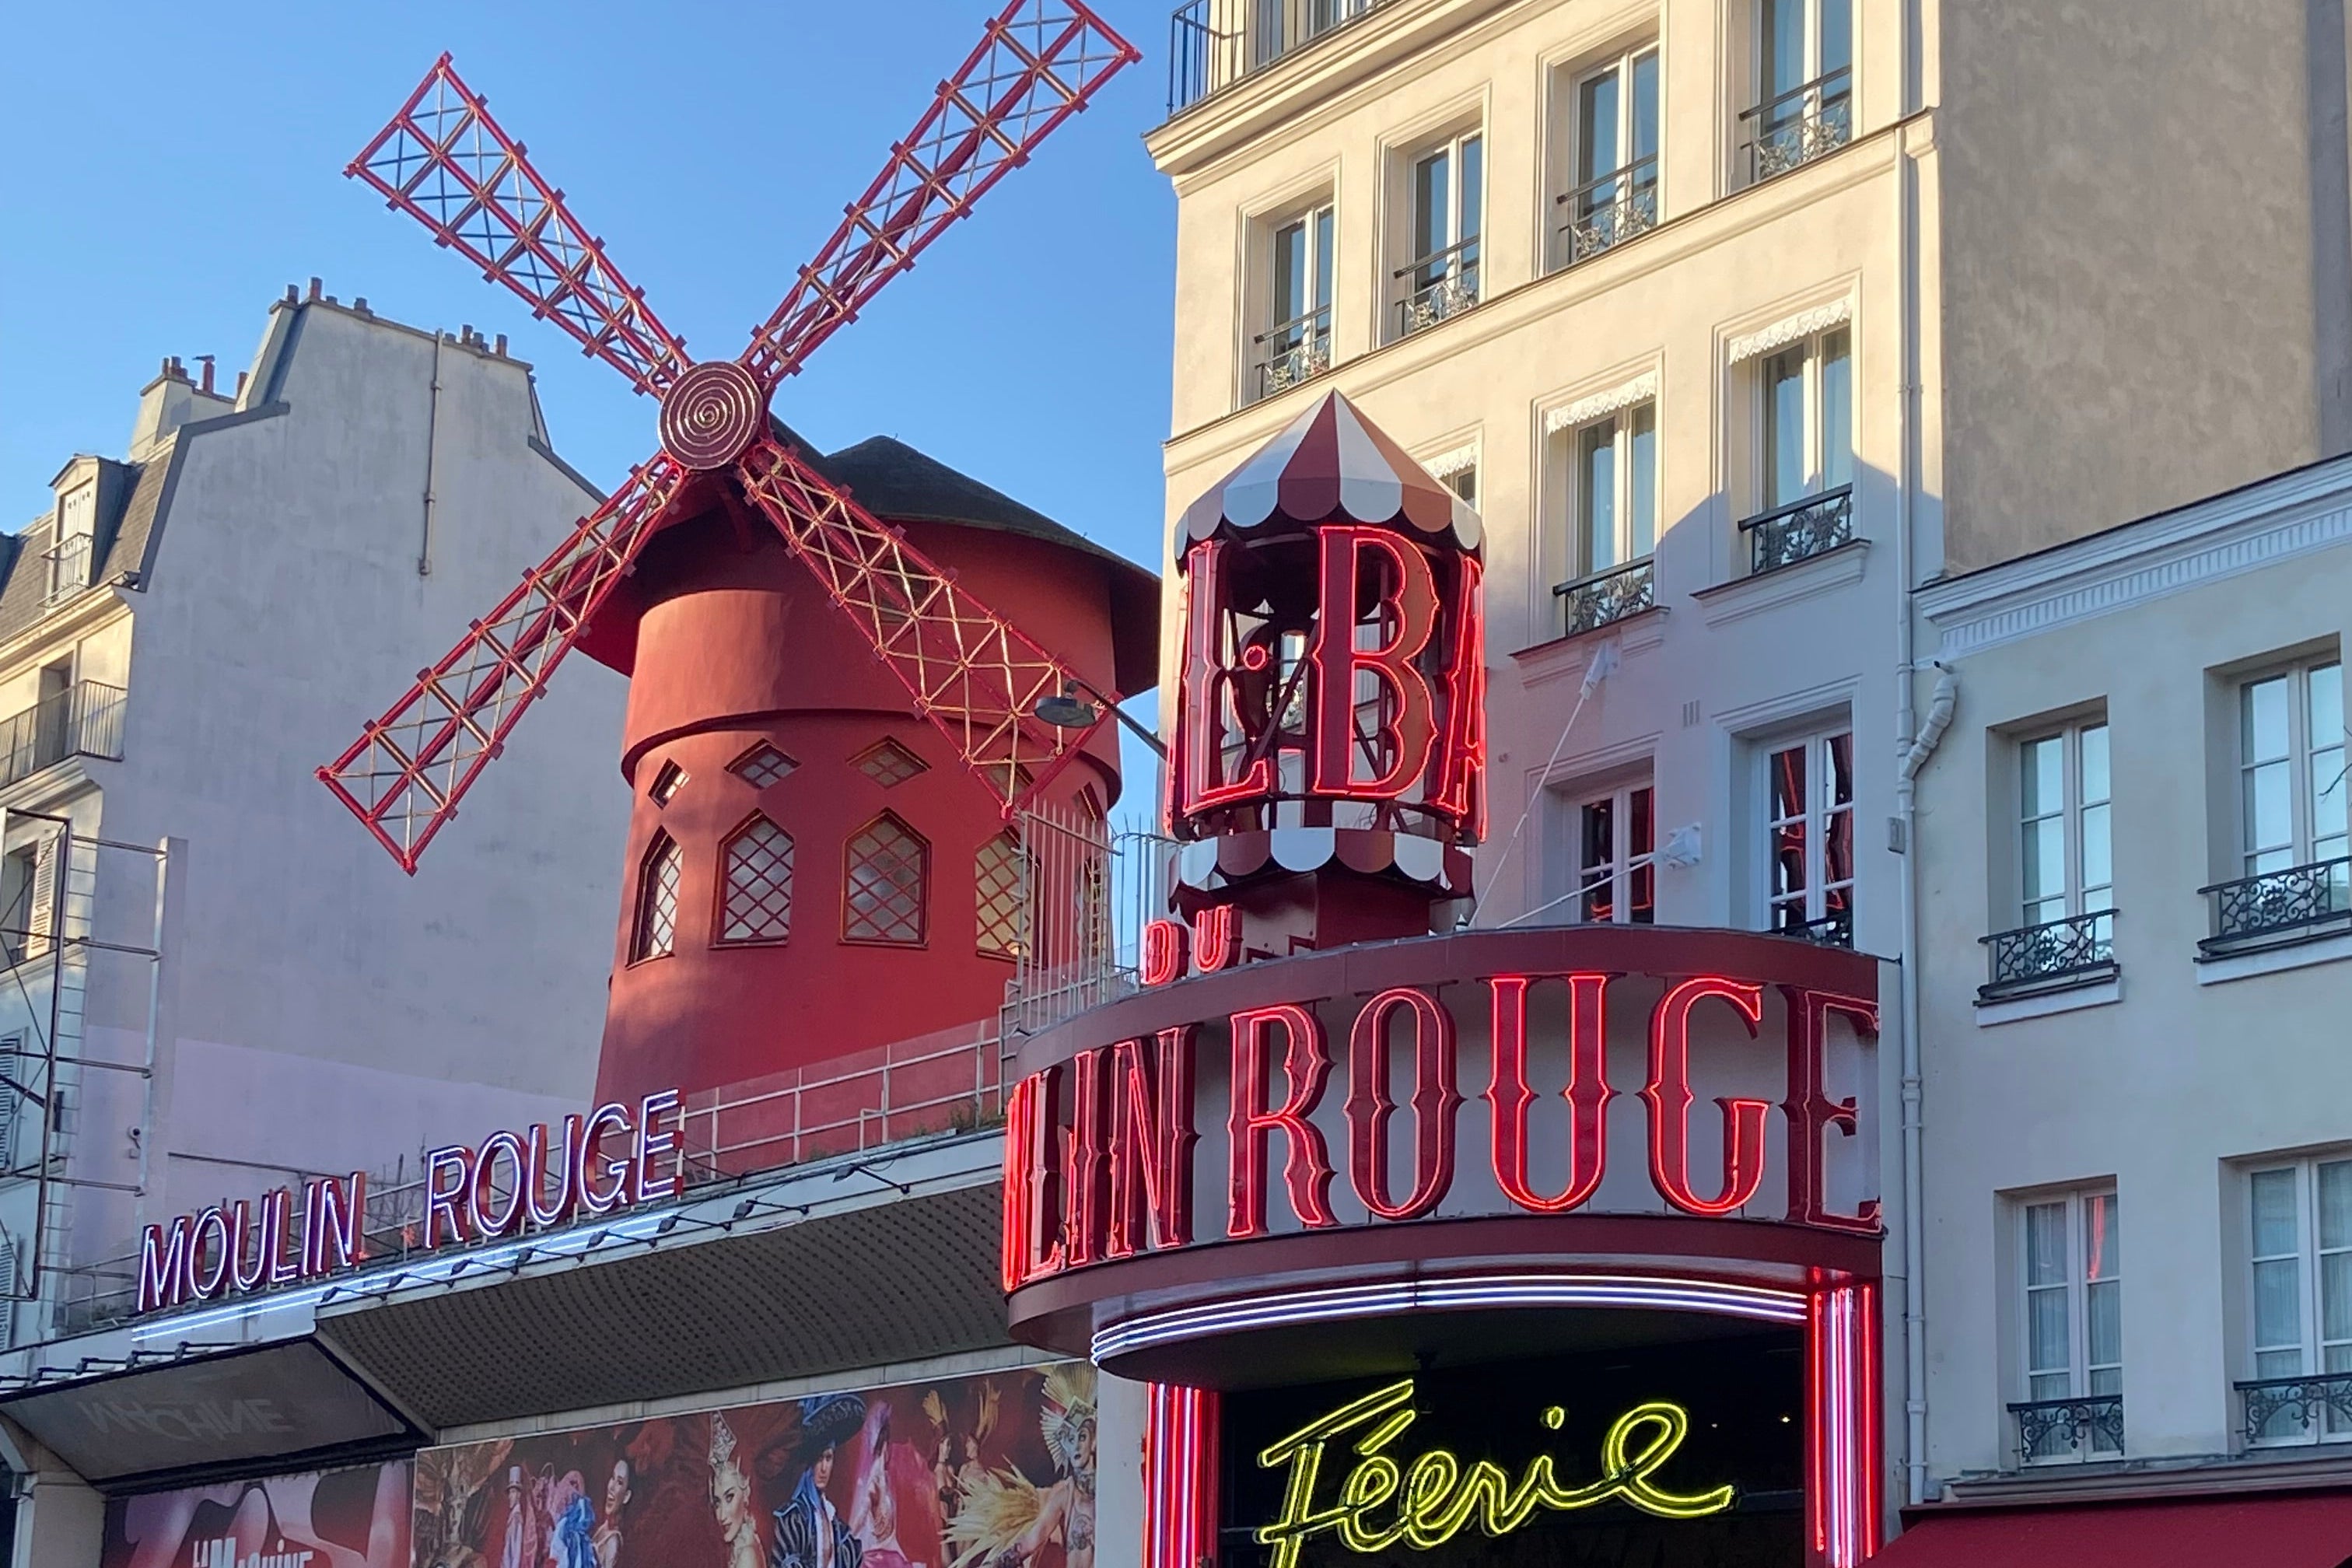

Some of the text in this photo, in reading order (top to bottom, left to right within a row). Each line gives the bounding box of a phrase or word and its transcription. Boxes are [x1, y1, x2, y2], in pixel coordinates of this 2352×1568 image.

[1140, 904, 1243, 986] DU
[137, 1088, 686, 1313] MOULIN ROUGE
[1227, 975, 1882, 1236] ROUGE
[1254, 1378, 1738, 1568] Féerie
